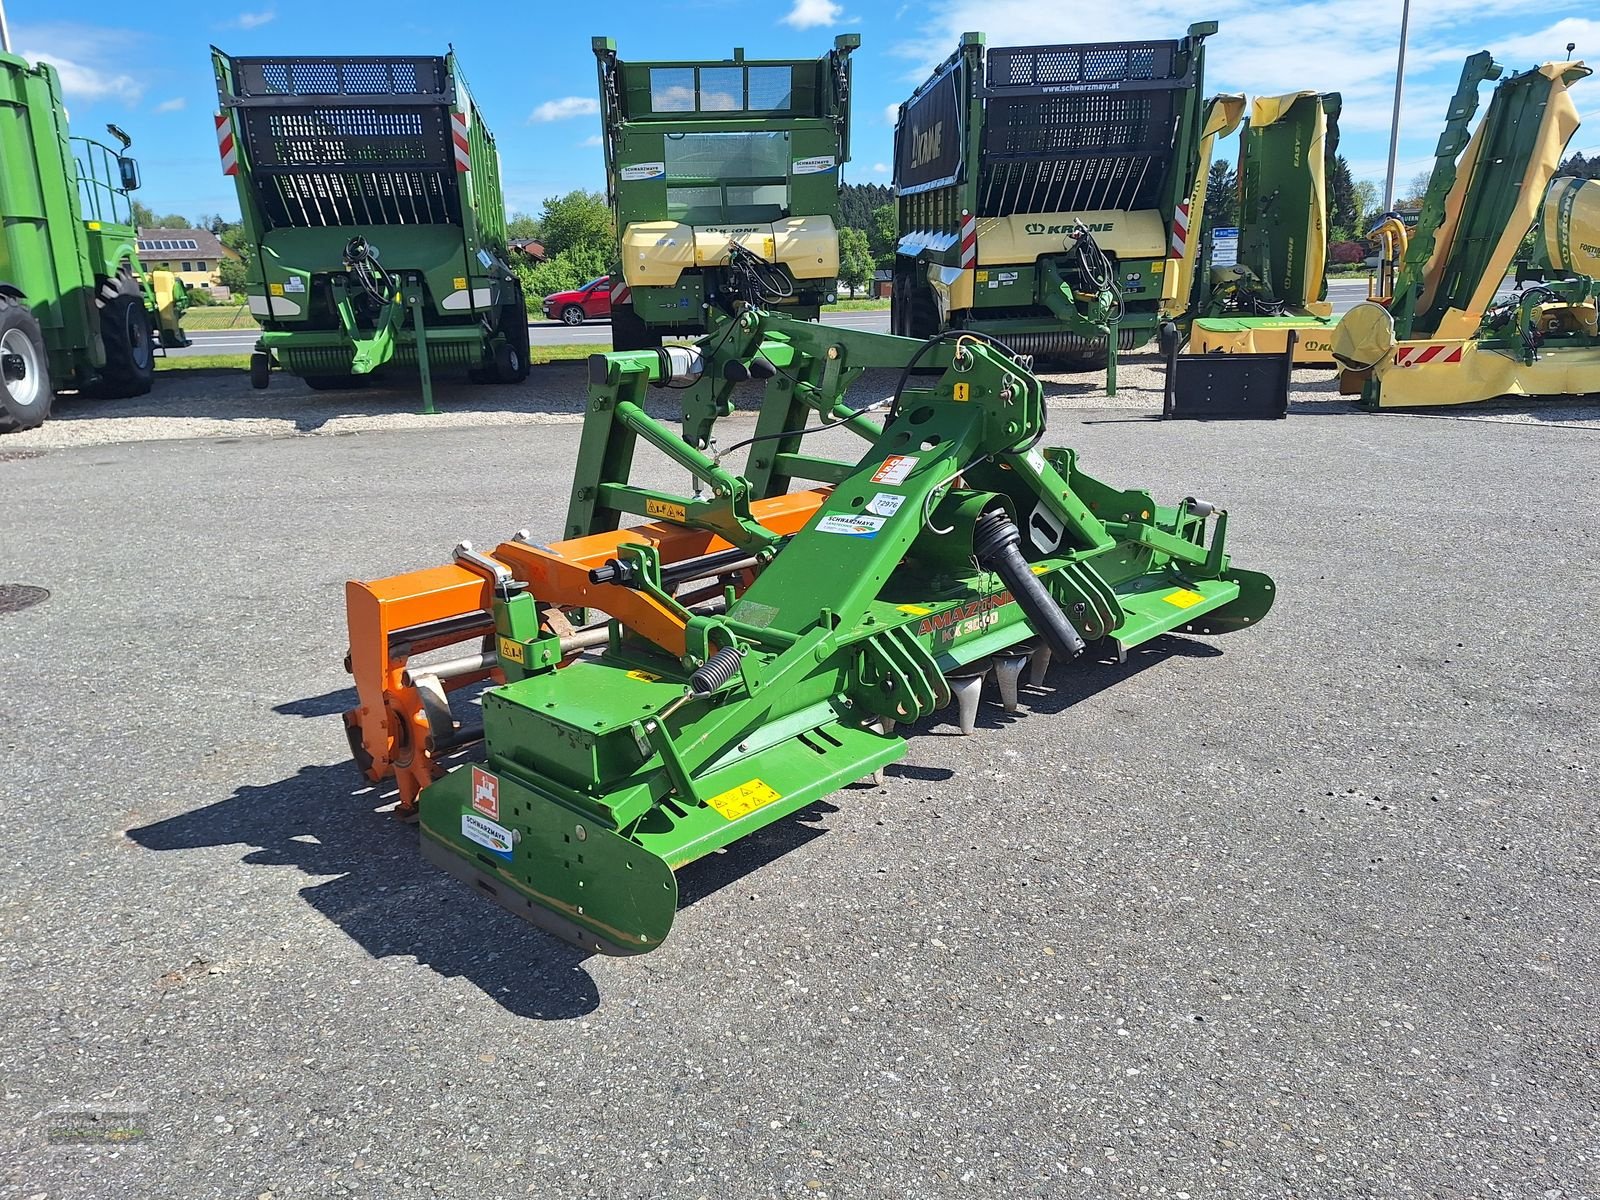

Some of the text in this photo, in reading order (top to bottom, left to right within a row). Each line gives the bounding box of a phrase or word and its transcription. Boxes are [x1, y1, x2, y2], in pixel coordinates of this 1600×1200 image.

[1042, 82, 1120, 93] www.schwarzmayr.at
[1286, 236, 1294, 278] KRONE
[877, 500, 899, 509] 72976
[828, 516, 875, 527] SCHWARZMAYR
[942, 623, 963, 643] KX
[466, 815, 506, 841] SCHWARZMAYR
